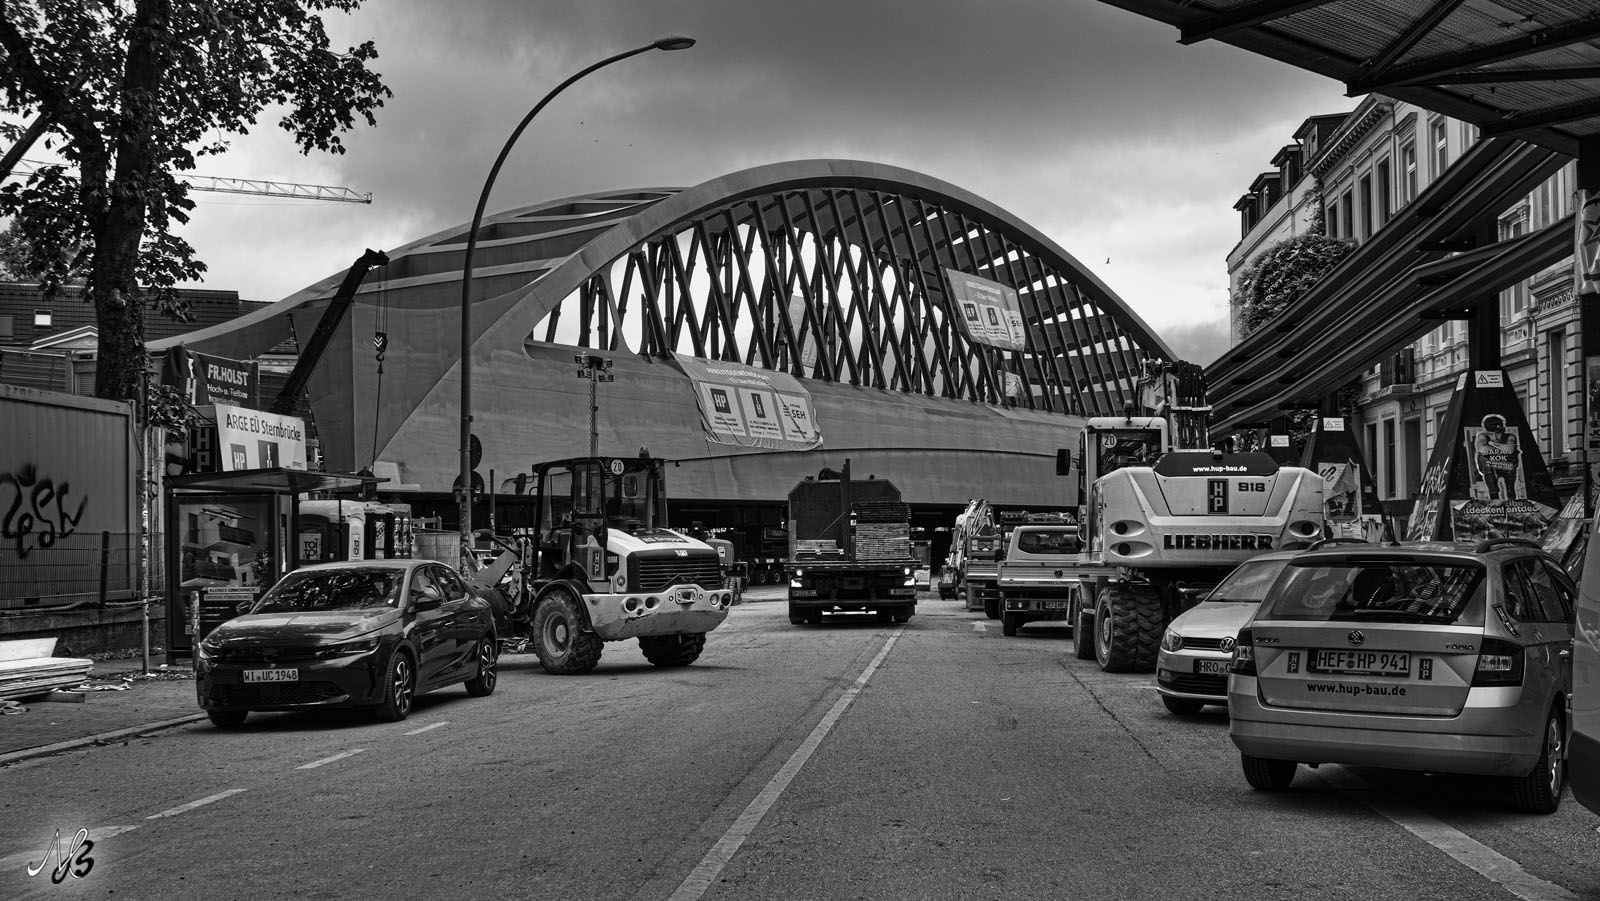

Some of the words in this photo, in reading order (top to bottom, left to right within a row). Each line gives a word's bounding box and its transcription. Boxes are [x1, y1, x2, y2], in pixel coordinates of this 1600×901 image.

[713, 394, 727, 408] HP
[791, 409, 806, 420] SEH
[226, 413, 249, 431] ARGE
[250, 415, 260, 433] EÜ
[261, 420, 301, 441] Sternbrücke
[1104, 435, 1115, 446] 20
[612, 461, 623, 472] 20
[1192, 465, 1248, 473] www.hup-bau.de
[1163, 534, 1274, 551] LIEBHERR
[1200, 661, 1219, 673] HRO
[1317, 651, 1346, 668] HEF
[1356, 652, 1376, 669] HP
[1380, 653, 1408, 671] 941
[244, 671, 255, 681] WI
[1306, 683, 1407, 697] www.hup-bau.de
